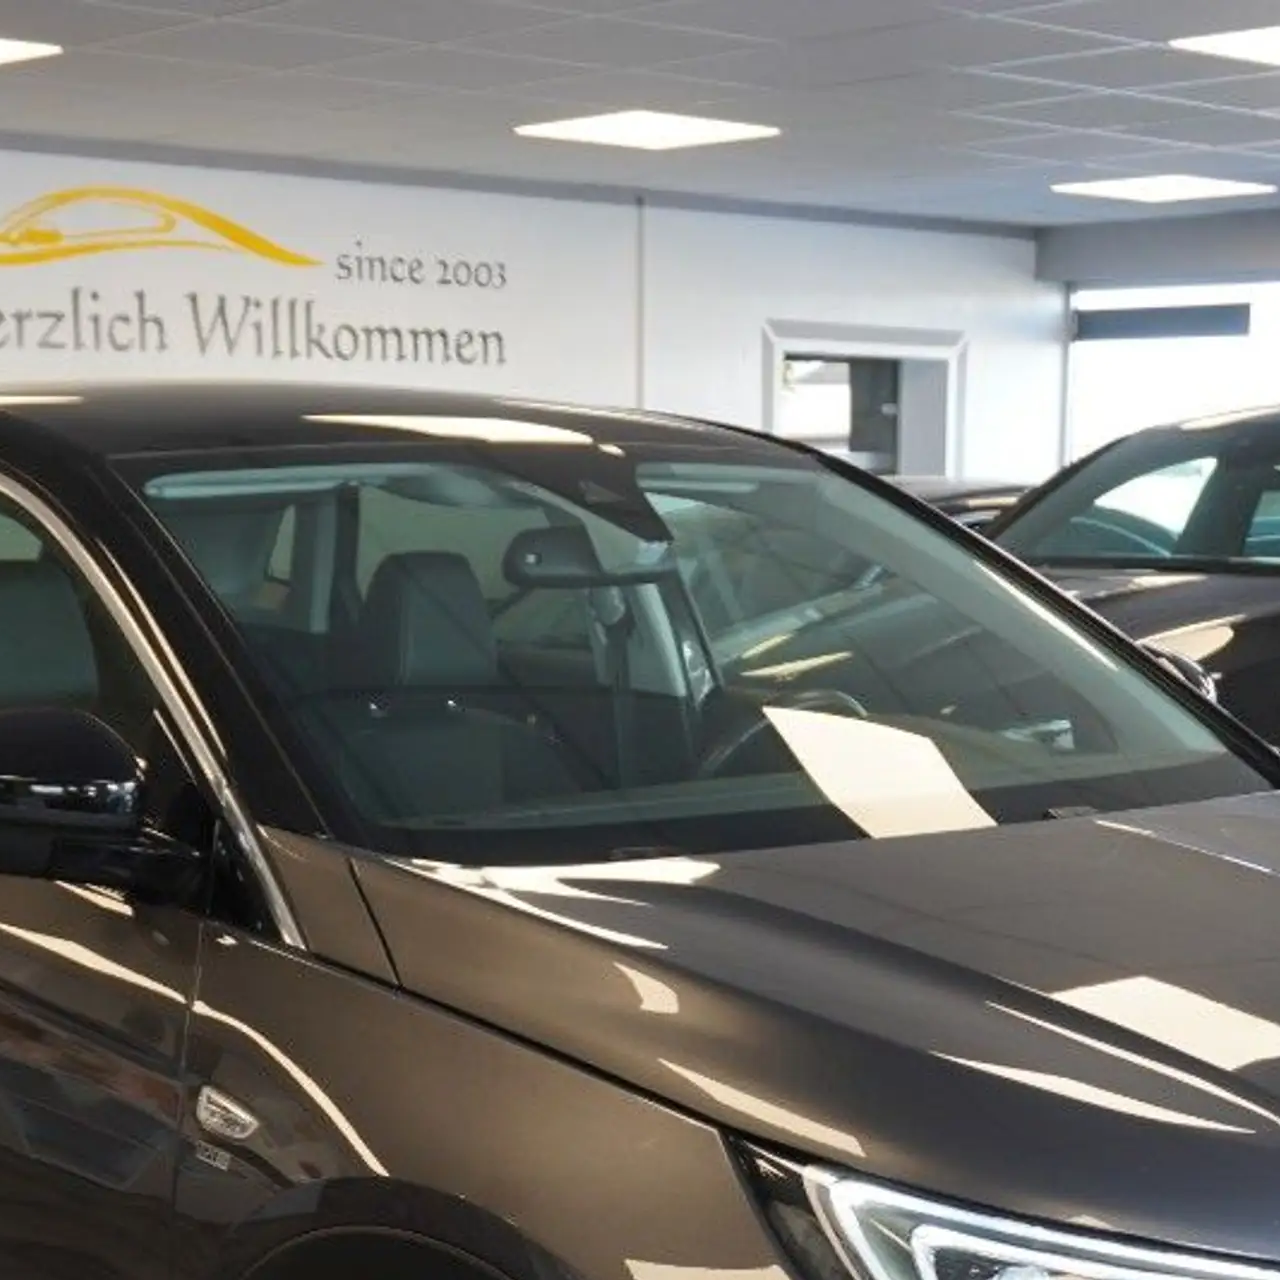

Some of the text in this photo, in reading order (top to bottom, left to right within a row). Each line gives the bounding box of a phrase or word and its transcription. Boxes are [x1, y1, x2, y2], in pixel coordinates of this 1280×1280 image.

[336, 240, 507, 288] since 2003
[186, 292, 507, 365] Willkommen
